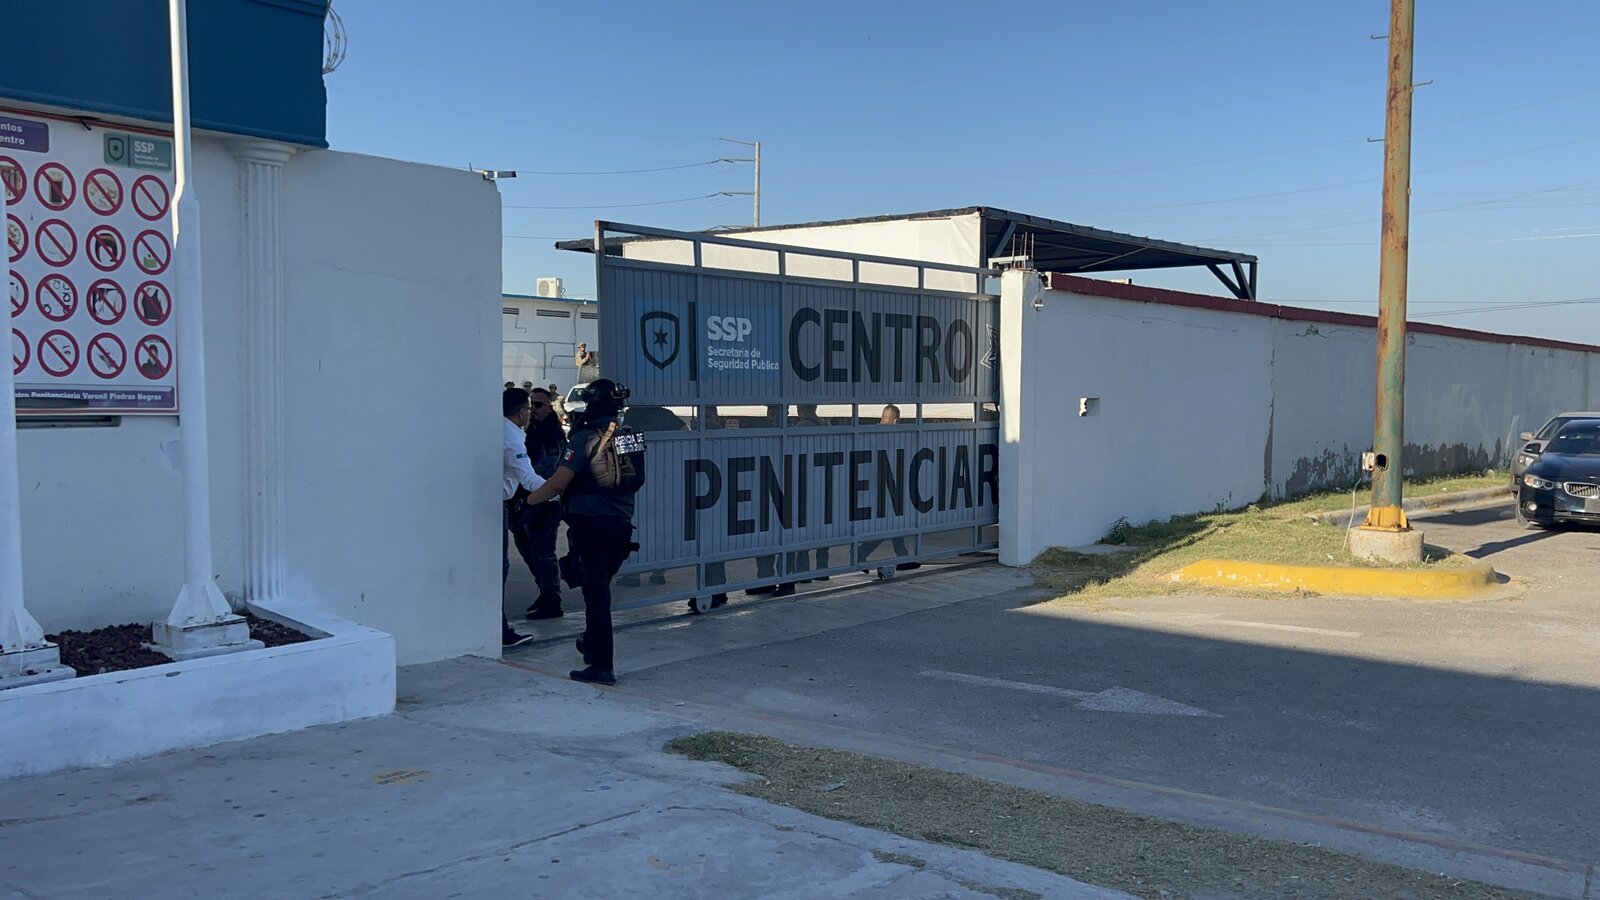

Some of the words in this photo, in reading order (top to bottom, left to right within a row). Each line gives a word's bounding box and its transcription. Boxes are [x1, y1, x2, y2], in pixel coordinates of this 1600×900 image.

[134, 141, 155, 153] SSP
[707, 315, 752, 342] SSP
[750, 347, 761, 358] de
[788, 307, 974, 384] CENTRO
[707, 357, 750, 371] Seguridad
[31, 391, 81, 399] Penitenciario
[82, 392, 108, 400] Varonil
[109, 392, 136, 400] Piedras
[137, 393, 162, 402] Negras
[615, 434, 636, 446] AGENCIA
[636, 432, 644, 443] DE
